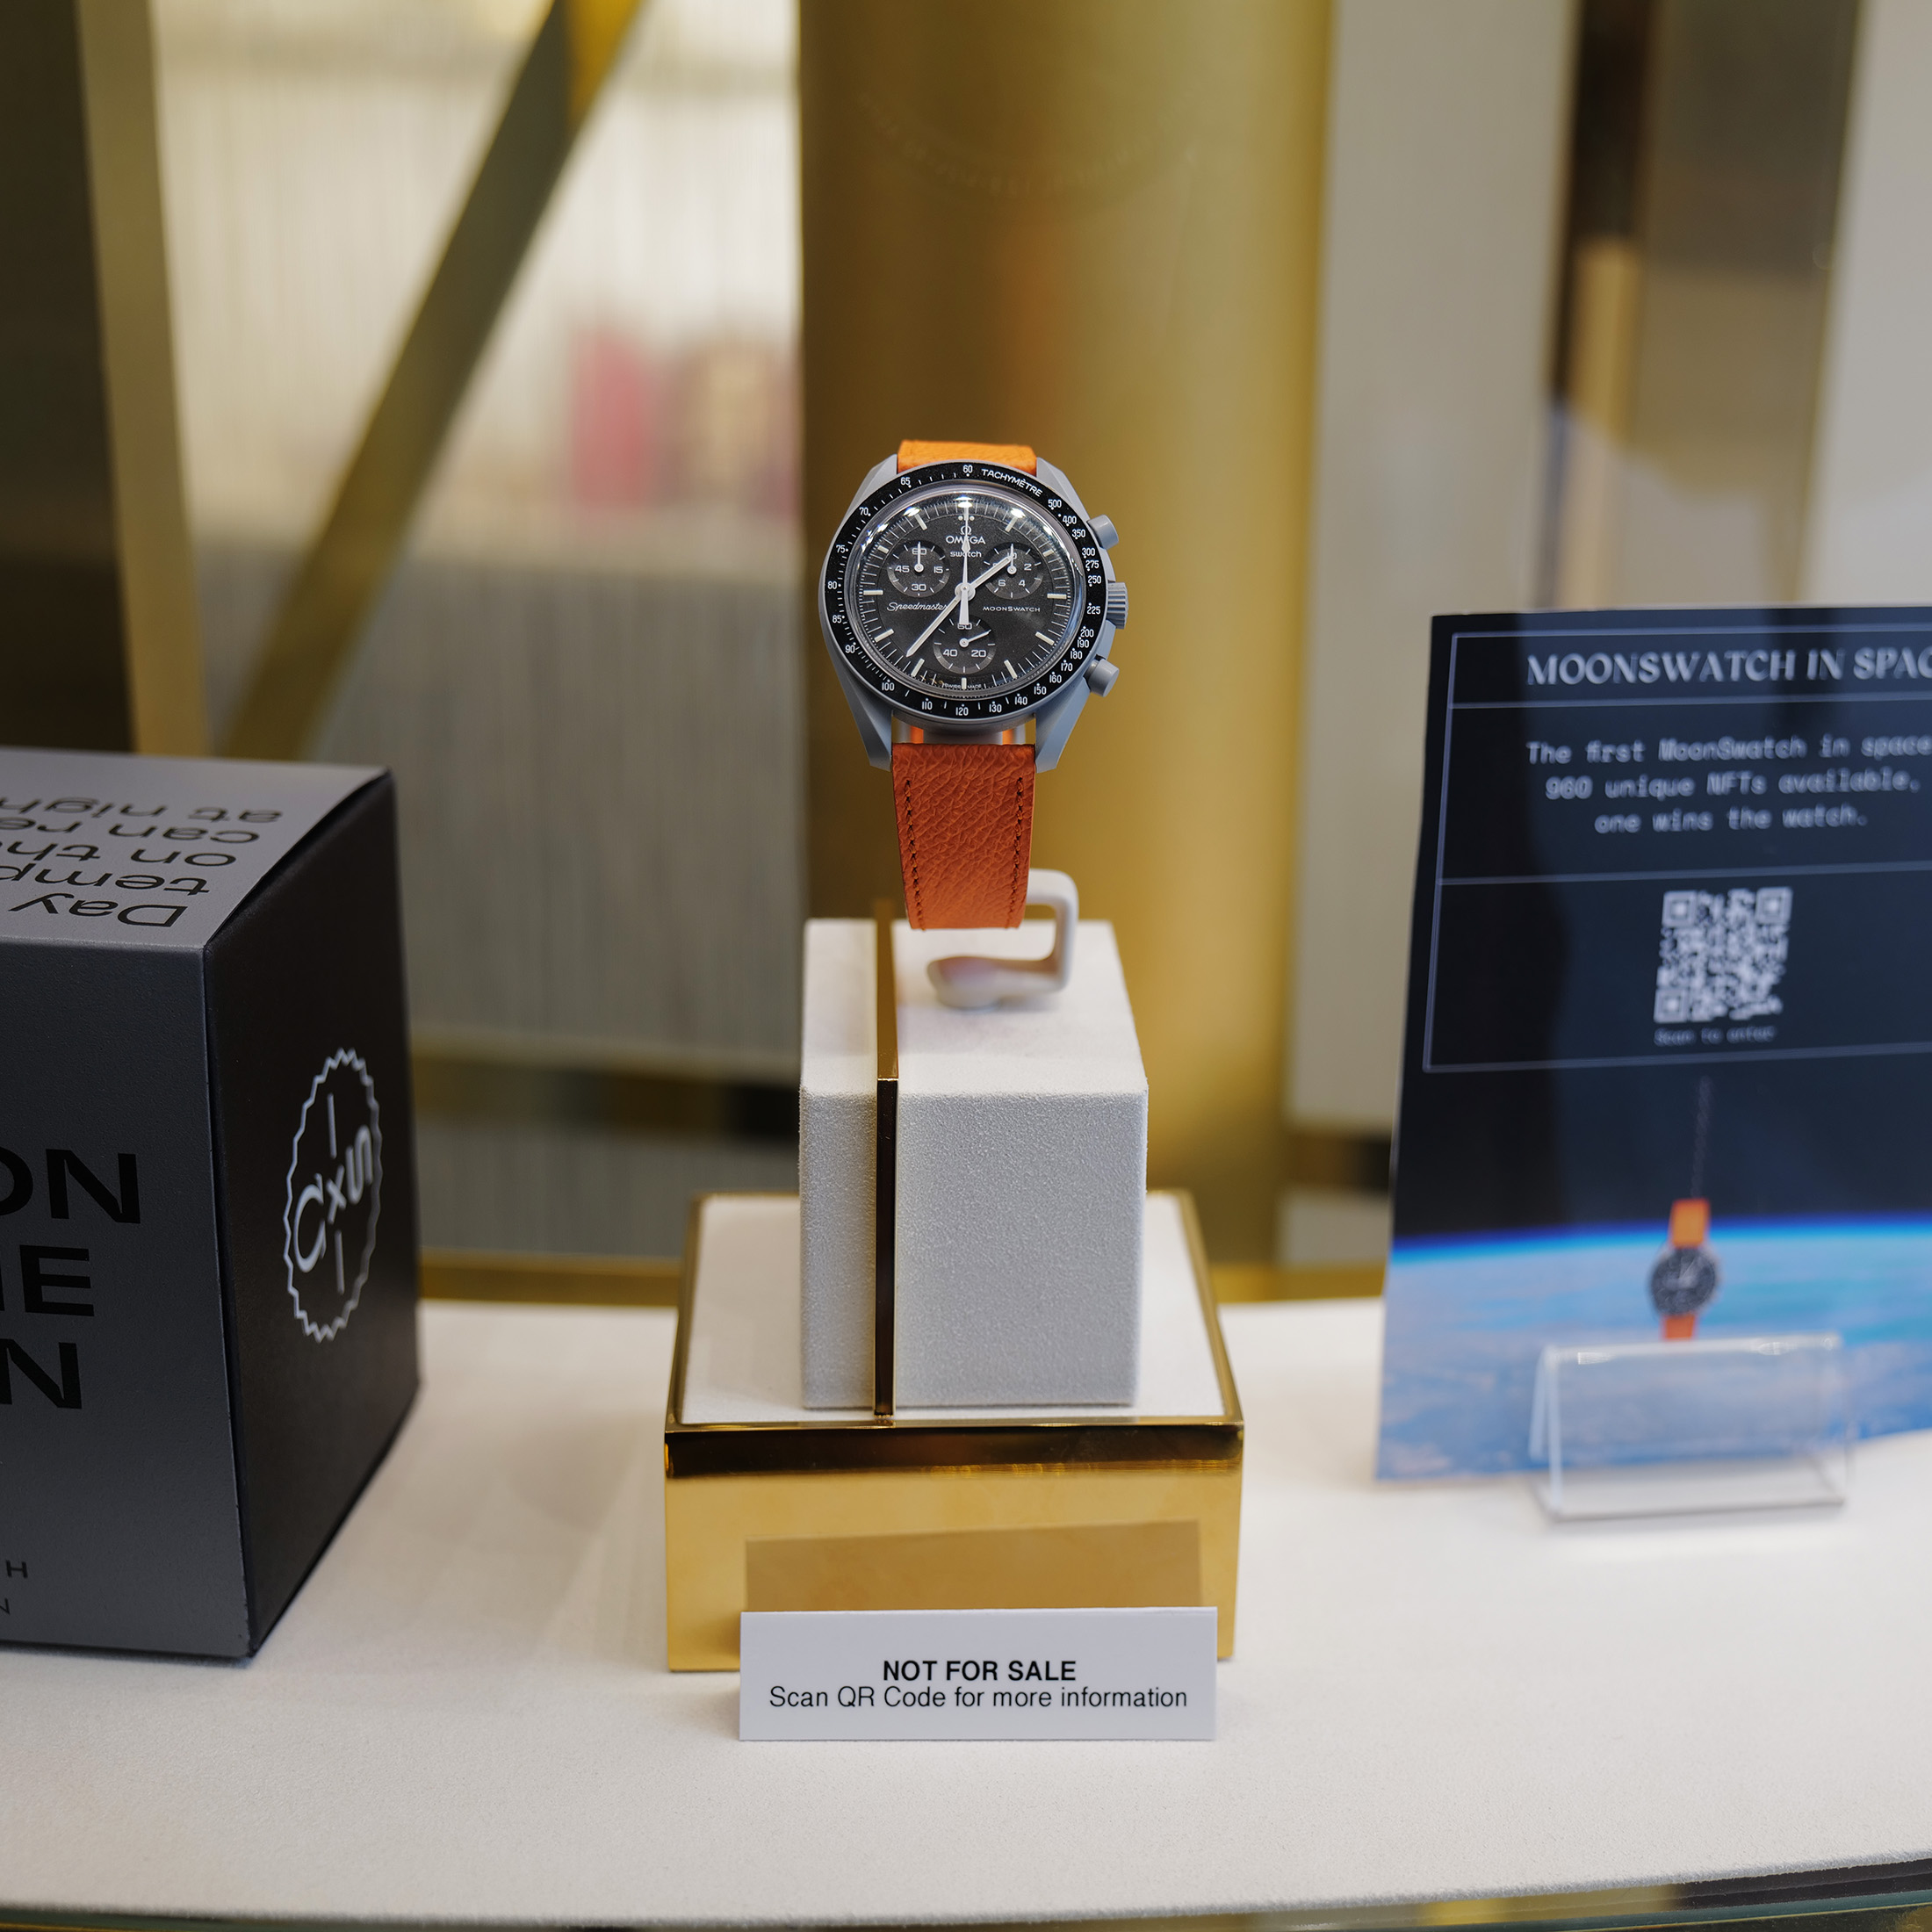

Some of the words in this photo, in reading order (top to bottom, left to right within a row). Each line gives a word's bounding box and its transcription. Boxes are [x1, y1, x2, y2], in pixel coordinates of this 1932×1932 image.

[962, 465, 973, 473] 60
[900, 477, 911, 486] 65
[981, 468, 1043, 497] TACHYMÈTRE
[1048, 499, 1062, 508] 500
[859, 507, 869, 515] 70
[1062, 515, 1077, 524] 400
[1071, 529, 1086, 537] 350
[946, 535, 986, 544] OMGA
[836, 544, 846, 553] 75
[1081, 547, 1095, 556] 300
[1085, 559, 1099, 568] 275
[1087, 575, 1102, 584] 250
[827, 580, 837, 589] 80
[886, 602, 948, 612] Speedmaster
[1086, 606, 1100, 615] 225
[832, 615, 842, 624] 85
[1080, 629, 1094, 638] 200
[1077, 639, 1089, 648] 190
[845, 645, 855, 653] 90
[971, 649, 987, 658] 20
[1070, 651, 1083, 660] 180
[1061, 662, 1073, 671] 170
[1527, 649, 1795, 685] MOONSWATCH
[1807, 648, 1845, 681] IN
[1049, 674, 1062, 683] 160
[882, 682, 895, 691] 100
[1034, 686, 1047, 695] 150
[1014, 696, 1028, 705] 140
[921, 701, 933, 710] 110
[989, 703, 1002, 713] 130
[955, 707, 969, 716] 120
[1525, 741, 1573, 764] The
[1658, 735, 1807, 762] MoonSwatch
[1819, 732, 1850, 758] in
[1546, 775, 1593, 800] 960
[1604, 773, 1696, 801] unique
[1706, 770, 1768, 796] NFTs
[1594, 813, 1642, 834] one
[1652, 807, 1714, 833] wins
[1727, 805, 1772, 830] the
[109, 824, 260, 844] can
[0, 840, 101, 861] th
[130, 848, 236, 867] on
[8, 892, 188, 927] Day
[883, 1660, 937, 1681] NOT
[946, 1660, 998, 1681] FOR
[1008, 1660, 1077, 1681] SALE
[769, 1685, 828, 1707] Scan
[838, 1685, 875, 1707] QR
[883, 1685, 946, 1707] Code
[955, 1686, 984, 1706] for
[993, 1691, 1052, 1707] more
[1061, 1686, 1187, 1707] information
